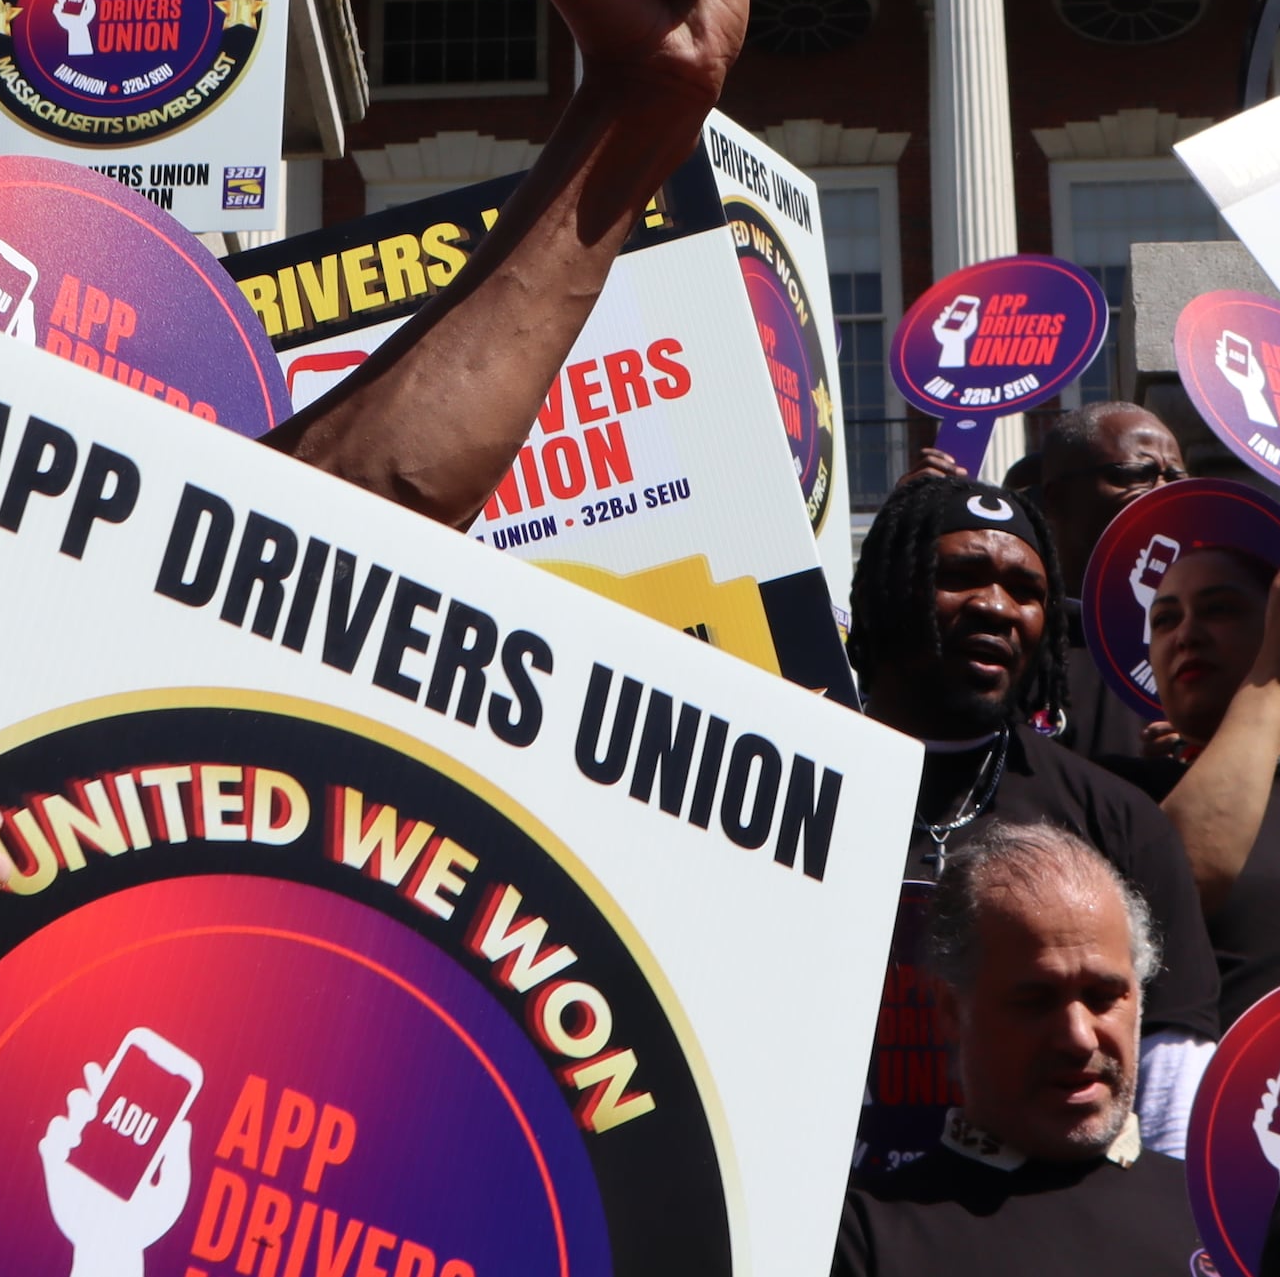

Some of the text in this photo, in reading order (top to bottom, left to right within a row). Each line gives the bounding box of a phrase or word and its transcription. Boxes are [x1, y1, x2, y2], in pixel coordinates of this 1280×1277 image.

[97, 22, 180, 53] UNION
[54, 63, 174, 96] IAM UNION 32BJ SEIU
[127, 89, 202, 133] DRIVERS
[195, 51, 237, 100] FIRST
[150, 164, 209, 186] UNION
[225, 167, 264, 179] 32BJ
[709, 126, 813, 235] DRIVERS UNION
[226, 195, 260, 205] SEIU
[750, 223, 809, 327] WE WON
[49, 274, 137, 355] APP
[978, 314, 1066, 335] DRIVERS
[985, 294, 1028, 315] APP
[969, 336, 1060, 366] UNION
[923, 373, 1040, 405] IAM 32BJ SEIU
[493, 477, 691, 551] UNION 32BJ SEIU
[154, 482, 554, 749] DRIVERS
[574, 662, 844, 882] UNION
[337, 784, 479, 922] WE
[472, 882, 656, 1135] WON
[102, 1096, 158, 1147] ADU
[214, 1073, 357, 1193] APP
